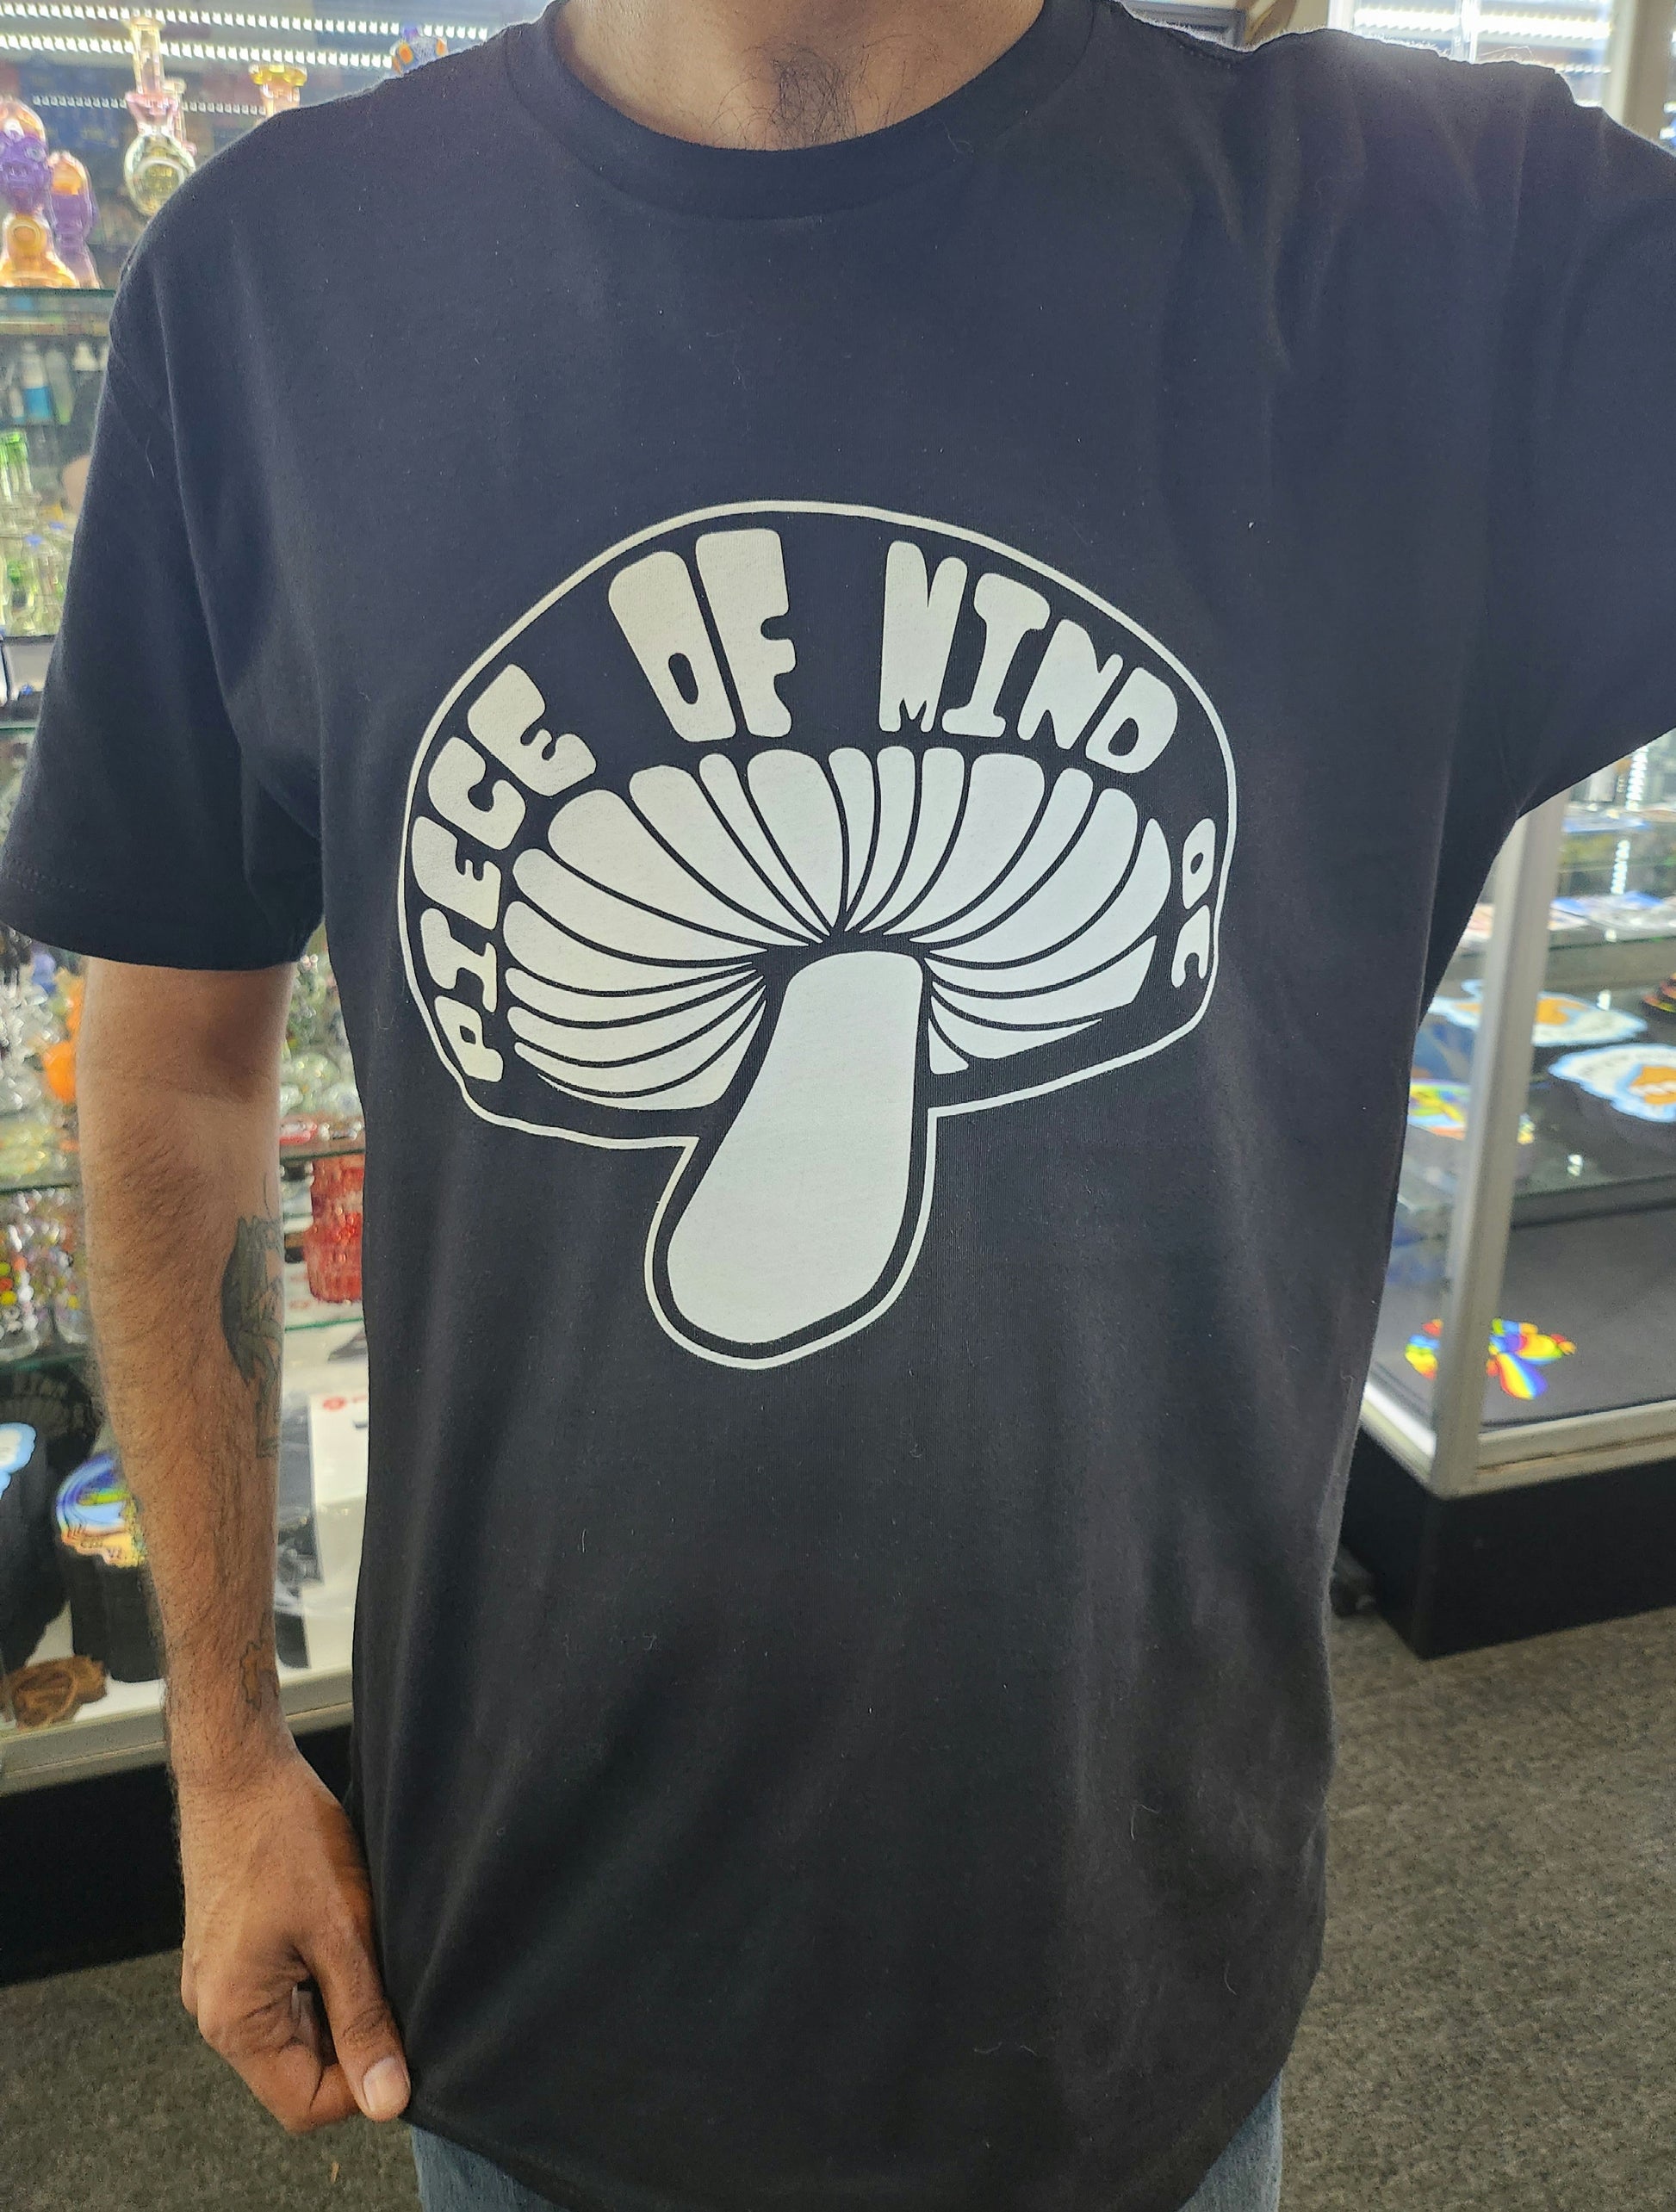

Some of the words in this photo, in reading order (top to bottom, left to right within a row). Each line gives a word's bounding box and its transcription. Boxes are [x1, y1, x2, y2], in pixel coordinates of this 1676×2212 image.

[411, 663, 597, 1082] PIECE
[608, 528, 797, 742] OF
[878, 540, 1178, 774] MIND
[1170, 818, 1216, 988] OC
